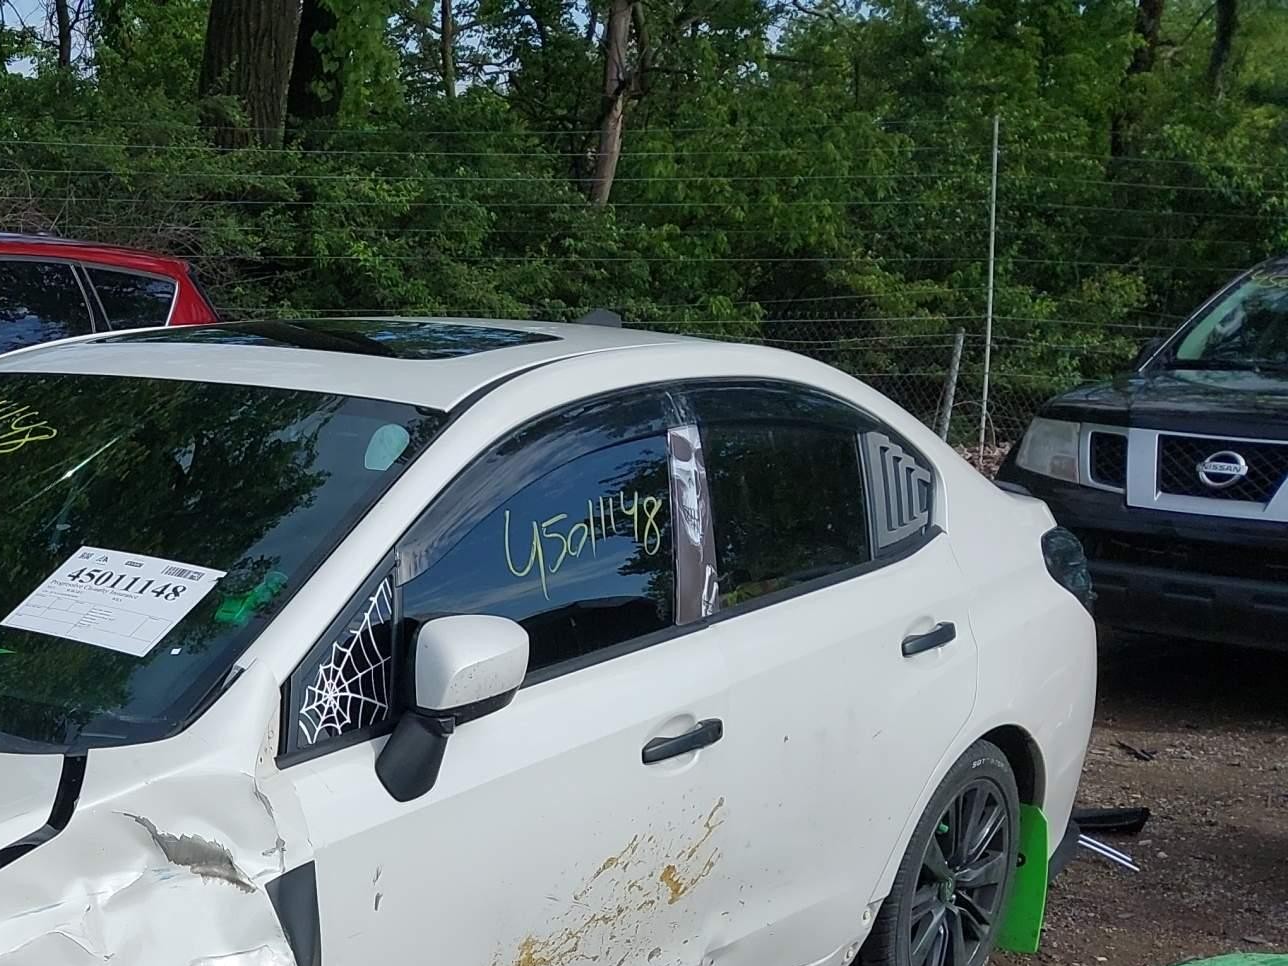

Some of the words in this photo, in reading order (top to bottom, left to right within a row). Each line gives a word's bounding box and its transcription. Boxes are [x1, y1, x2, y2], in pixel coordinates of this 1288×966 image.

[1202, 463, 1242, 473] NISSAN
[503, 490, 663, 600] 45011148
[67, 567, 187, 602] 45011148
